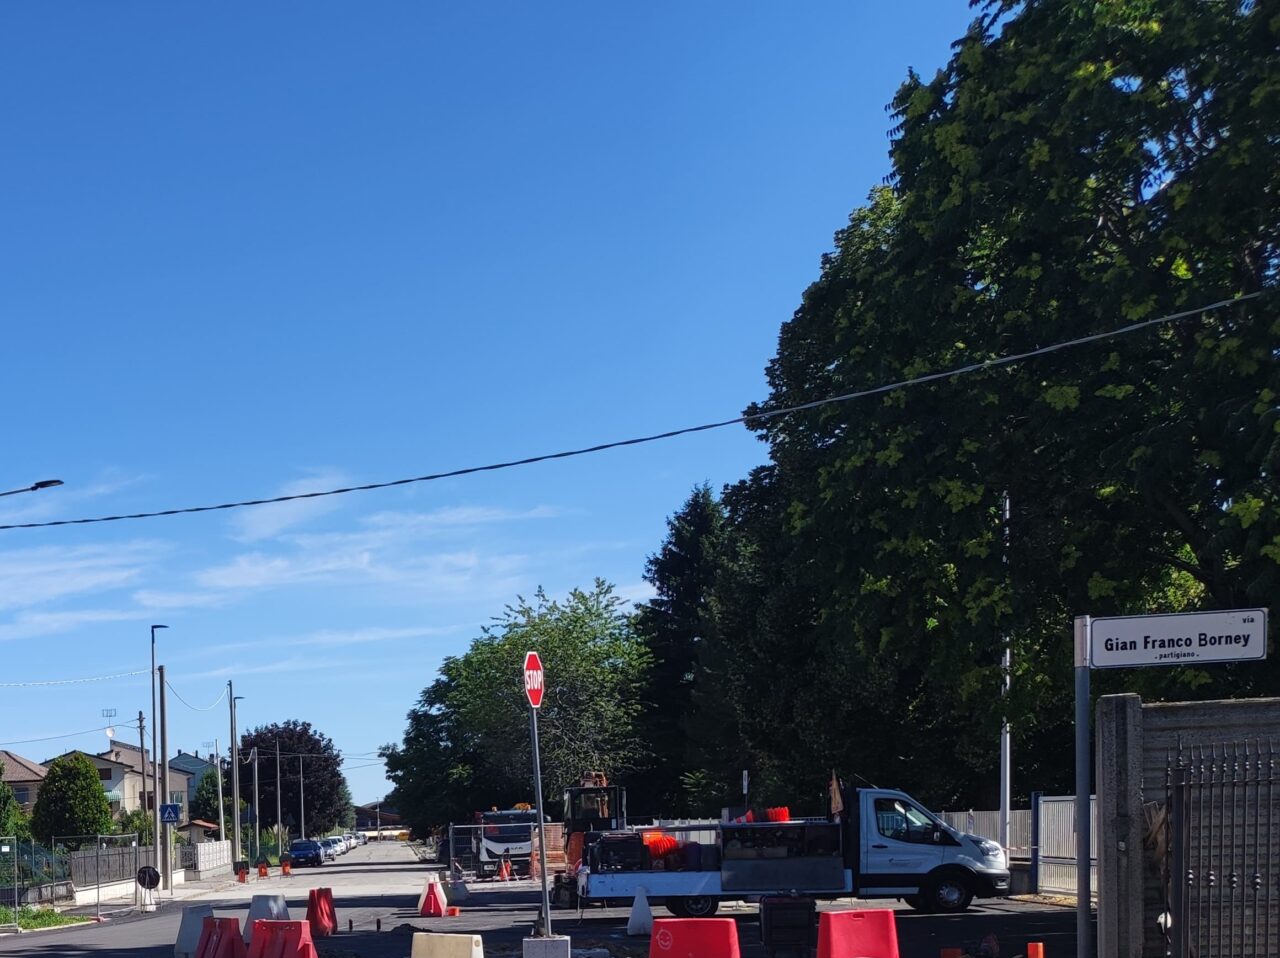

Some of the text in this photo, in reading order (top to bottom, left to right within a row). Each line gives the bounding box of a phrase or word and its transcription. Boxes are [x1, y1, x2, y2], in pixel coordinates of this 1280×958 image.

[1242, 616, 1255, 624] via
[1104, 632, 1251, 652] Gian Franco Borney
[1158, 651, 1195, 660] partigiano
[525, 669, 542, 690] STOP
